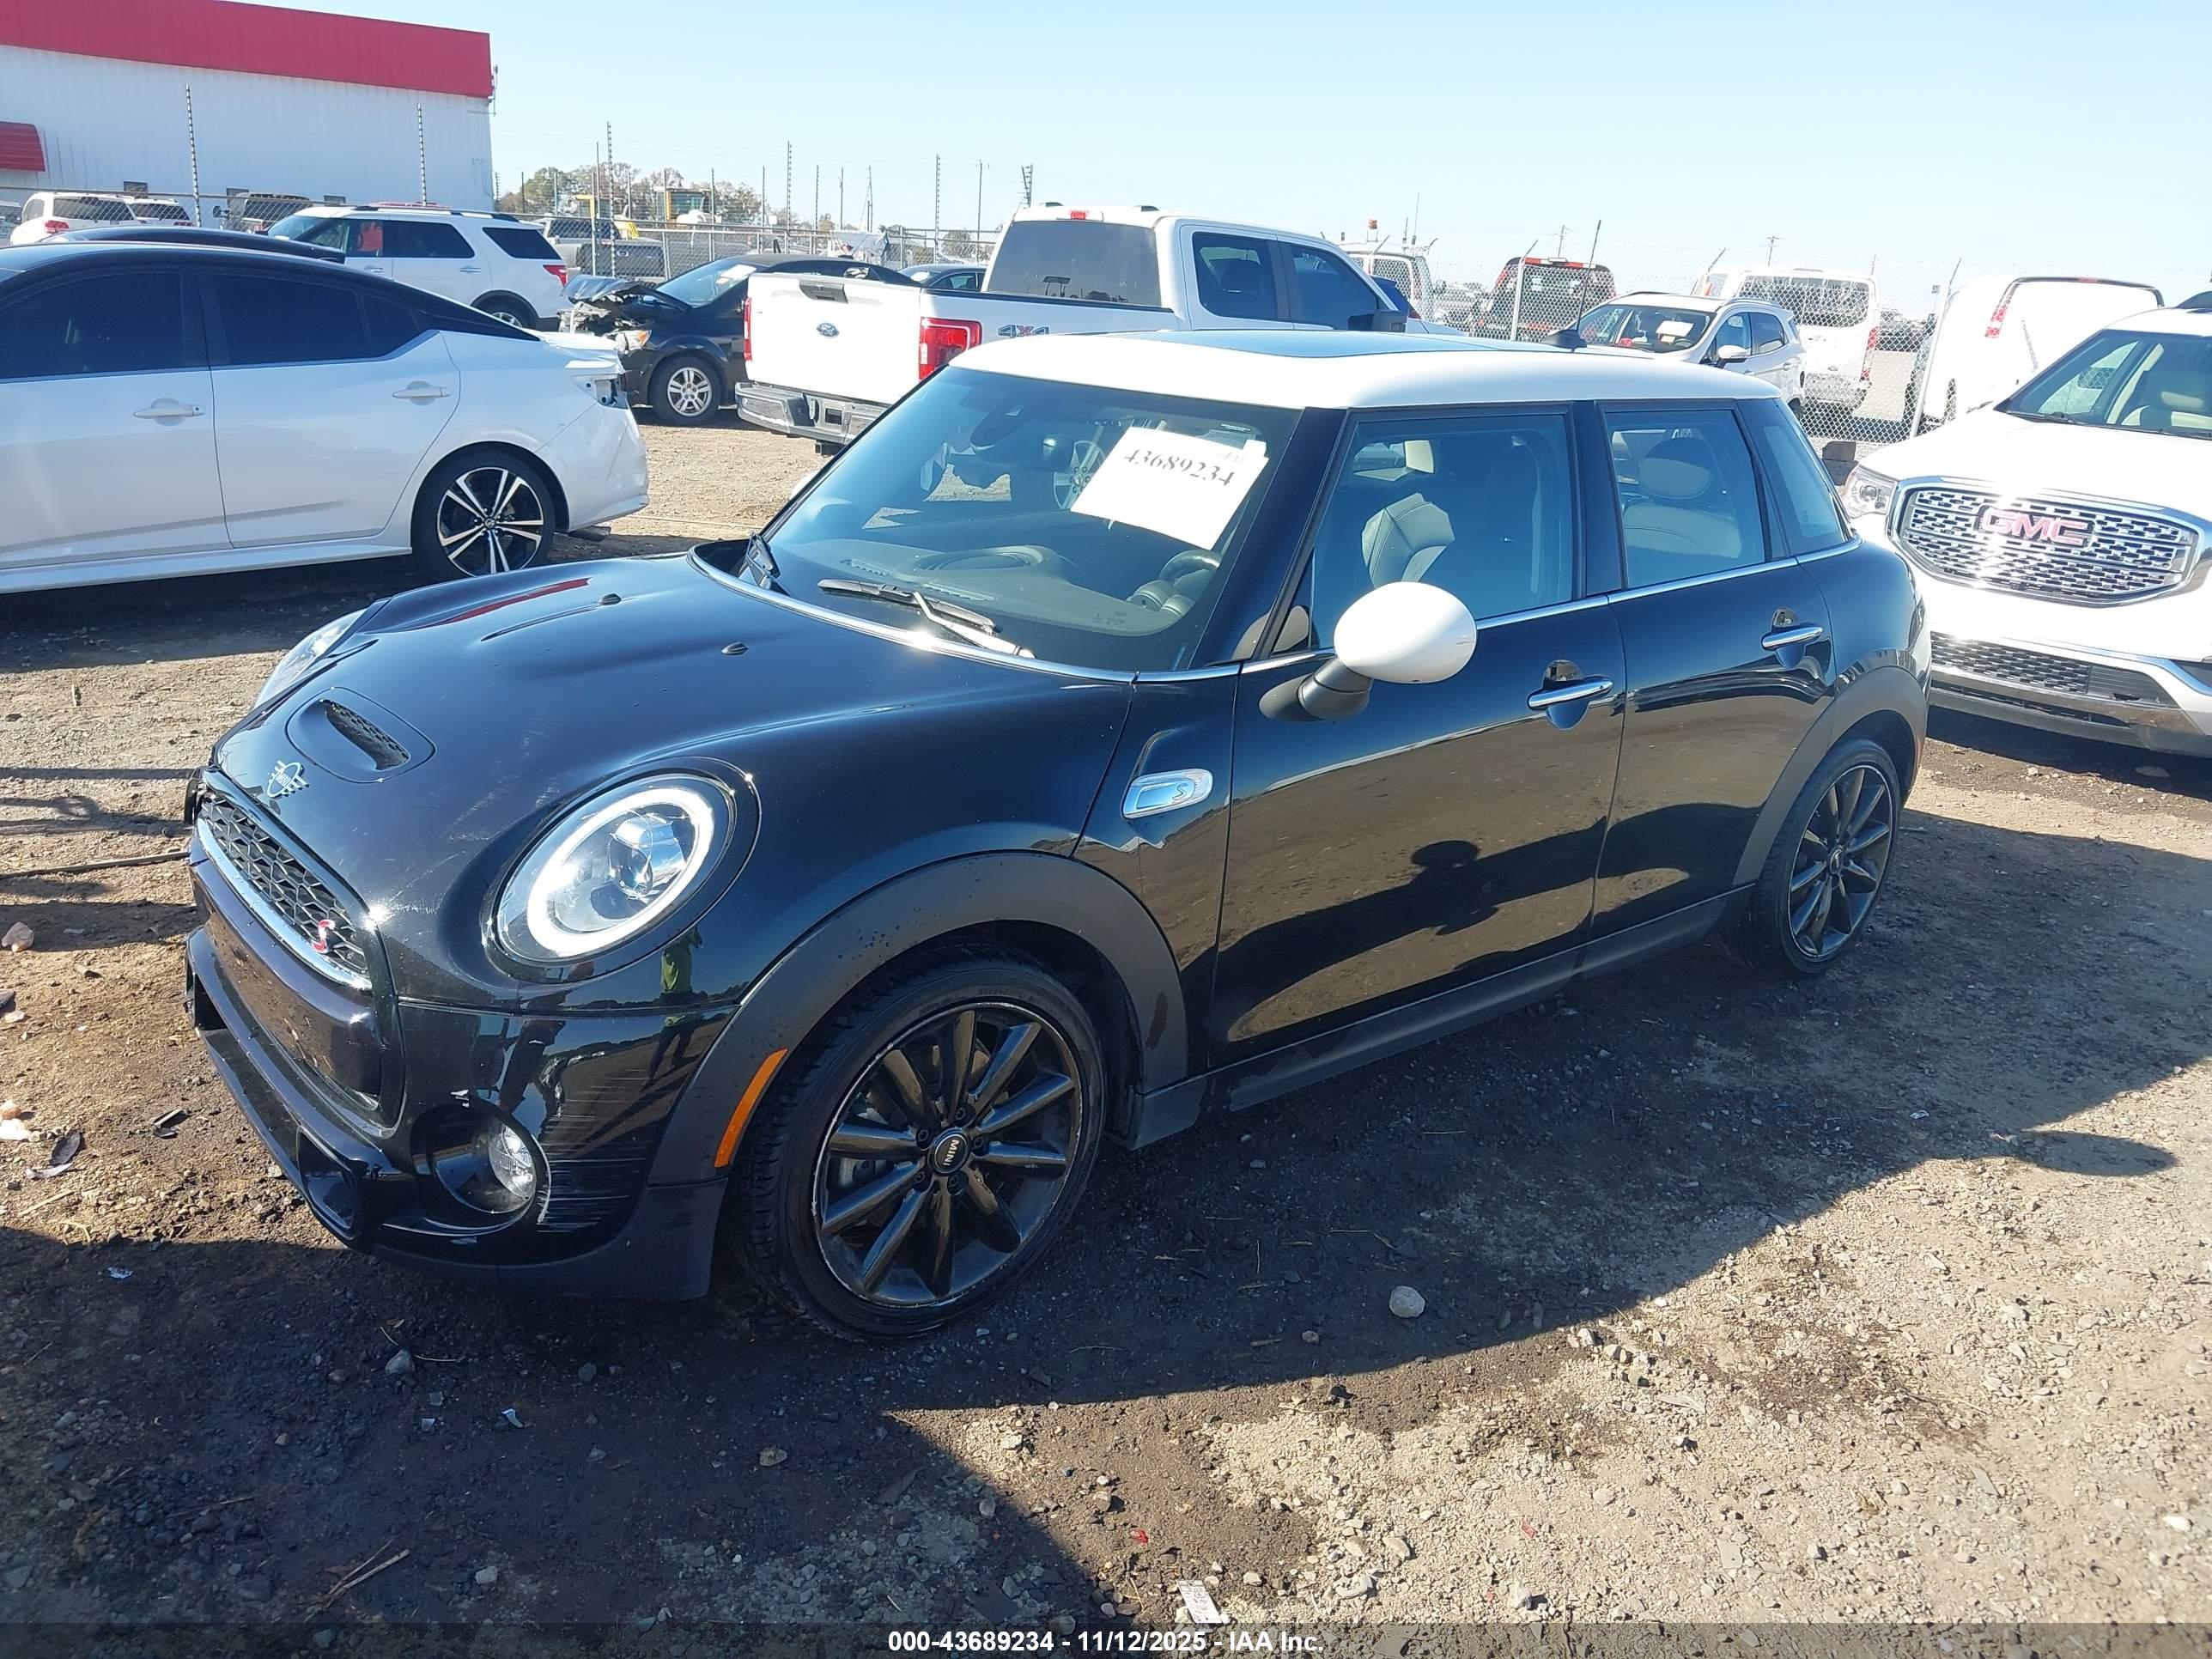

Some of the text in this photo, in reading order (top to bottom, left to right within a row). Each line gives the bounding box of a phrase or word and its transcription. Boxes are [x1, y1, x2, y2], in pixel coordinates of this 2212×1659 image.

[1124, 448, 1235, 486] 43689234
[1980, 507, 2088, 545] GMC
[1172, 782, 1188, 800] S
[311, 919, 336, 953] S
[943, 1139, 960, 1165] MINI
